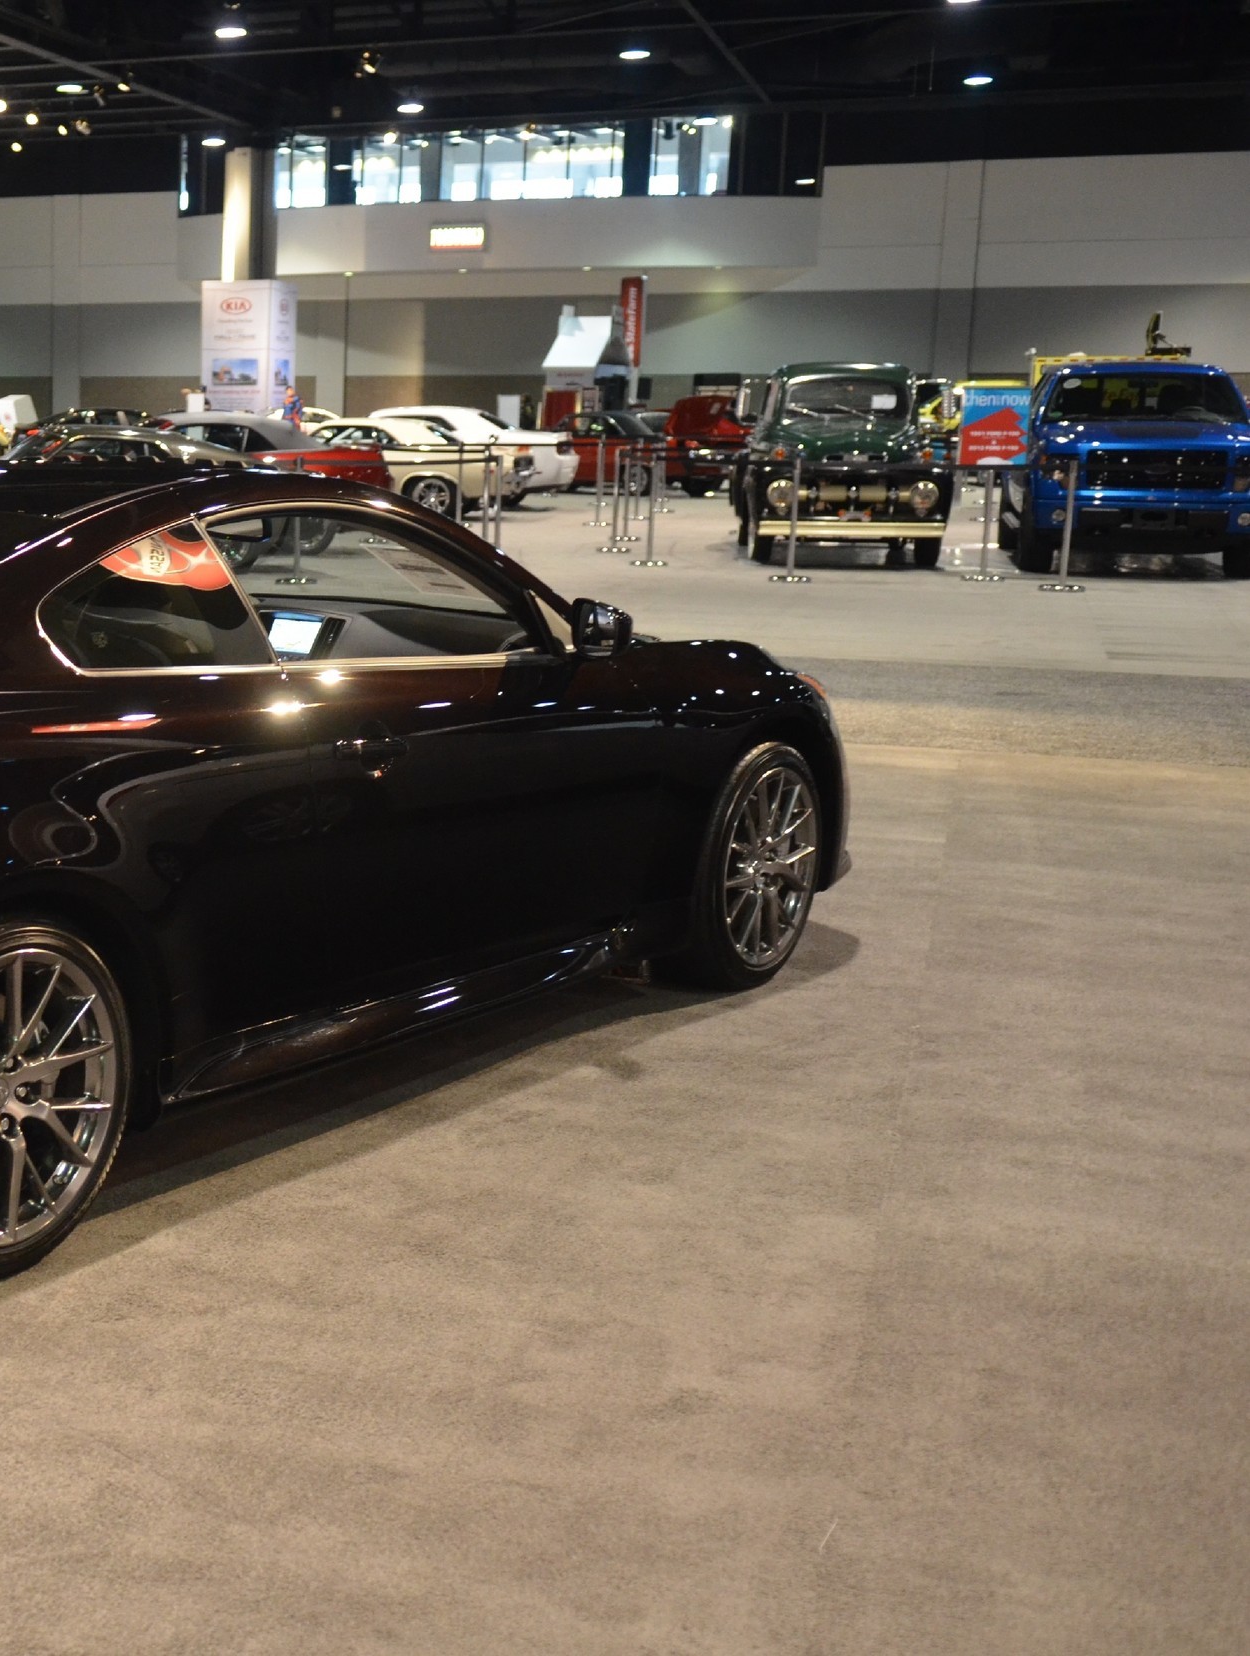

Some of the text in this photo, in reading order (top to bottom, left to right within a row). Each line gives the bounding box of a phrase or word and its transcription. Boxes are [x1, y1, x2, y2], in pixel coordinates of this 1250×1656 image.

[226, 302, 246, 310] KIA
[964, 390, 996, 406] then
[1002, 395, 1031, 406] now
